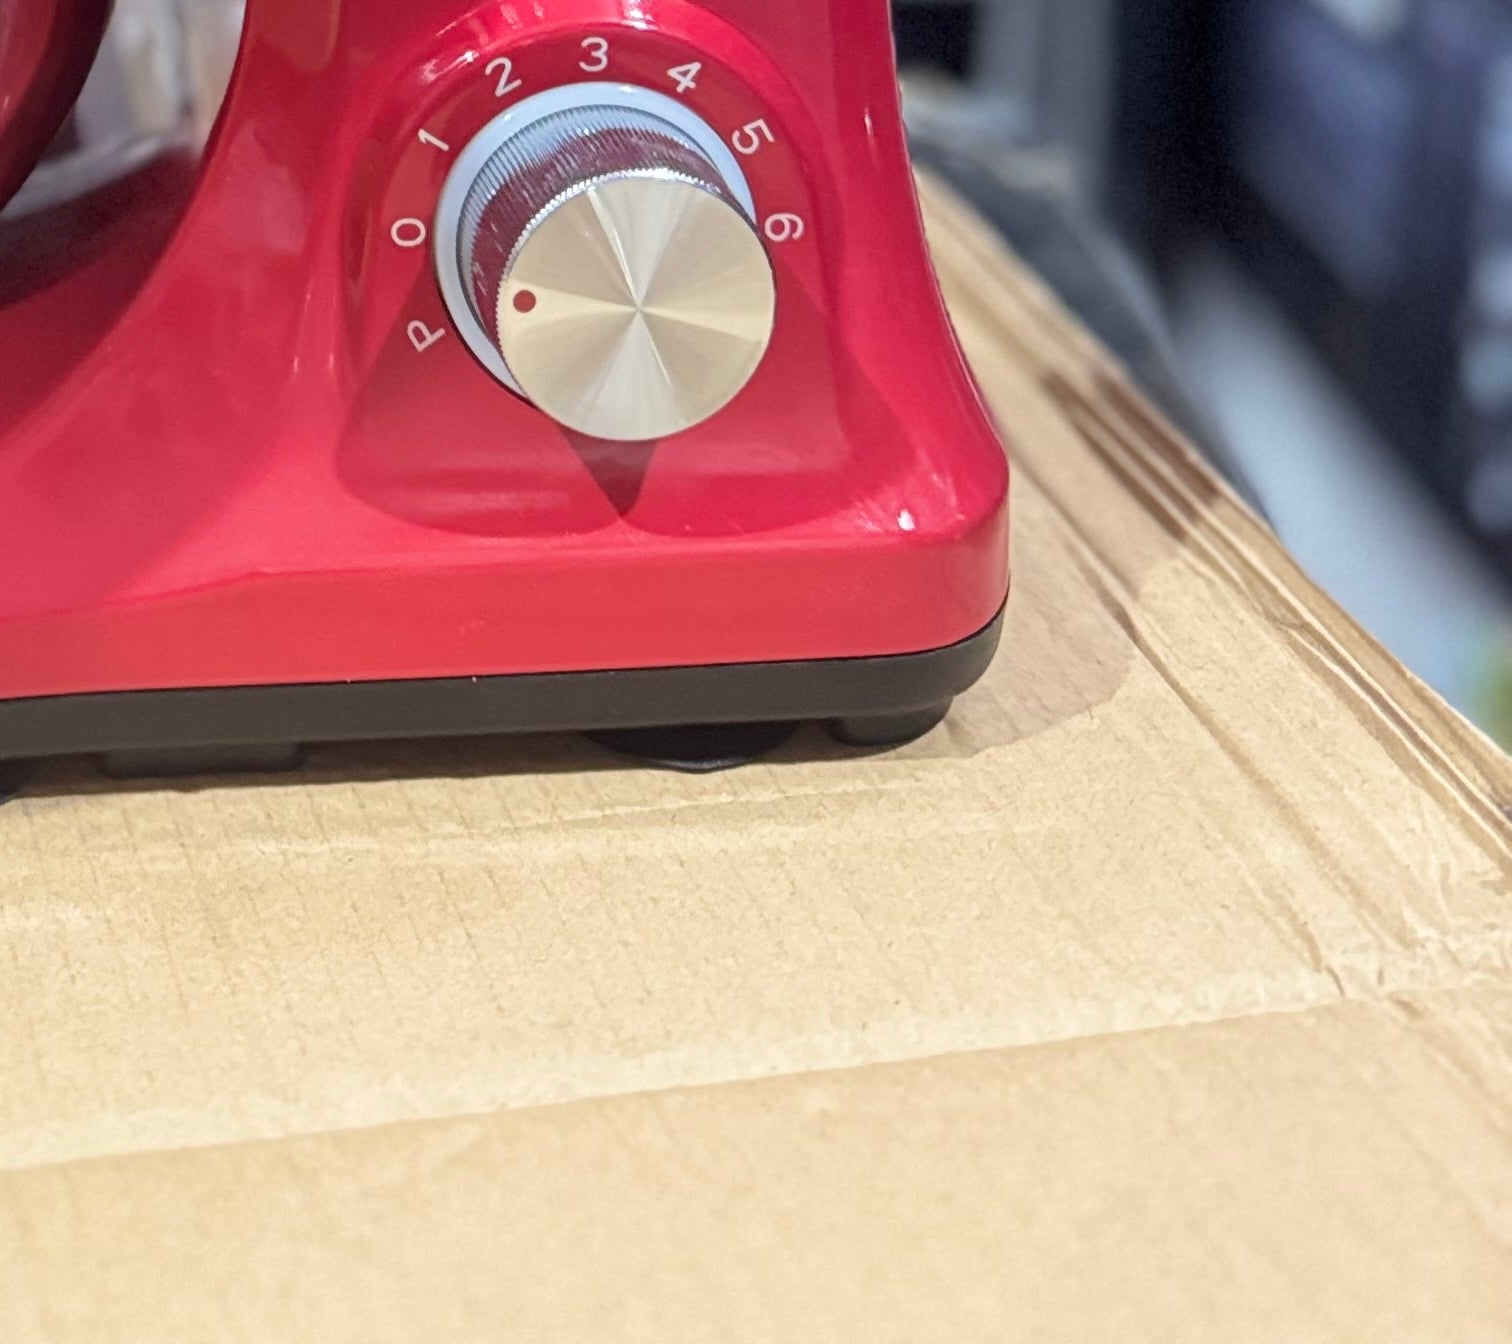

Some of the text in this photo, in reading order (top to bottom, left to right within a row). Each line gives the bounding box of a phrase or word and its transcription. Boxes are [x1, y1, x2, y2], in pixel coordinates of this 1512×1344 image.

[579, 36, 609, 72] 3
[484, 56, 523, 98] 2
[666, 60, 703, 94] 4
[417, 127, 450, 153] 1
[731, 118, 776, 156] 5
[764, 212, 805, 244] 6
[406, 319, 446, 353] P
